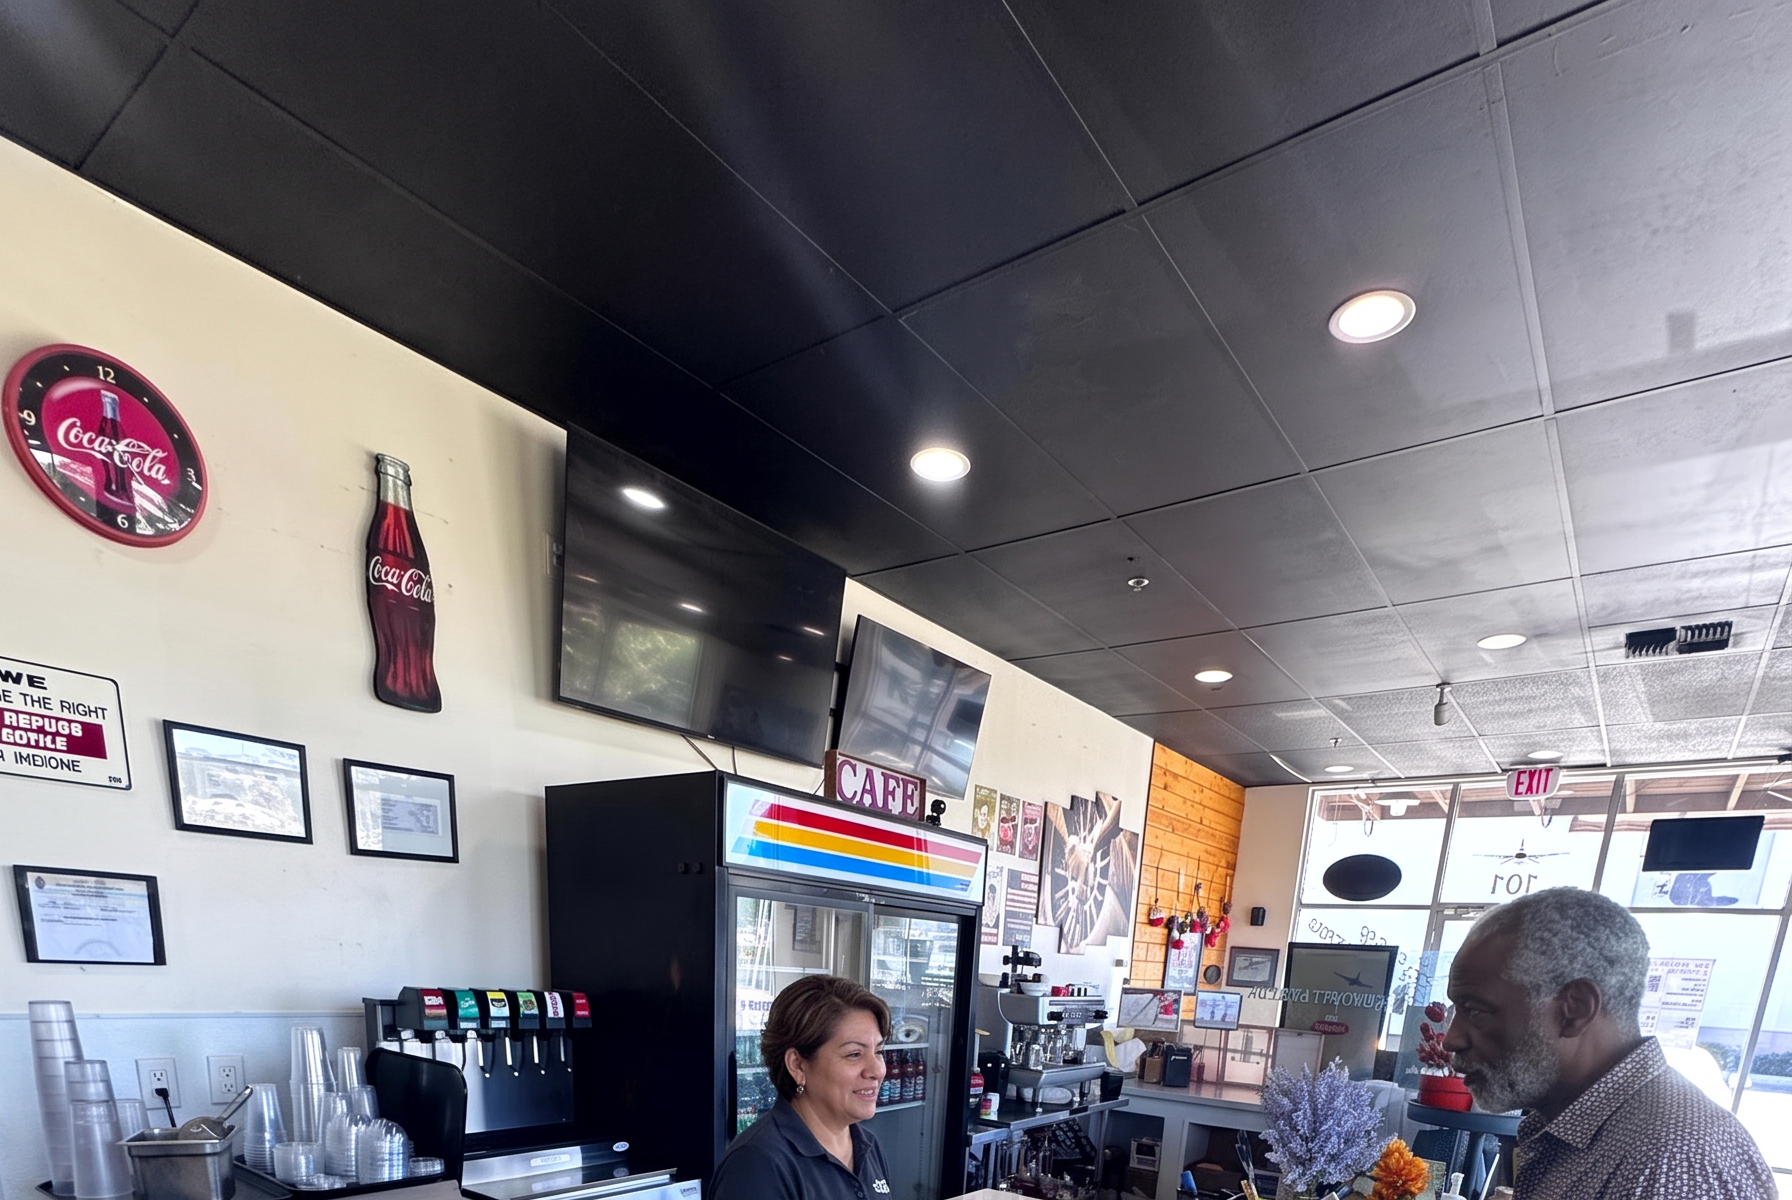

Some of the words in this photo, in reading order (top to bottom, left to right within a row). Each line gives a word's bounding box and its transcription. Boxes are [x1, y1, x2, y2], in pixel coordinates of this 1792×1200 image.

[97, 366, 116, 383] 12
[18, 409, 36, 425] 9
[187, 467, 196, 482] 3
[117, 514, 129, 528] 6
[0, 669, 48, 690] WE
[19, 692, 53, 711] THE
[60, 700, 107, 720] RIGHT
[837, 759, 919, 819] CAFE
[1514, 768, 1553, 796] EXIT
